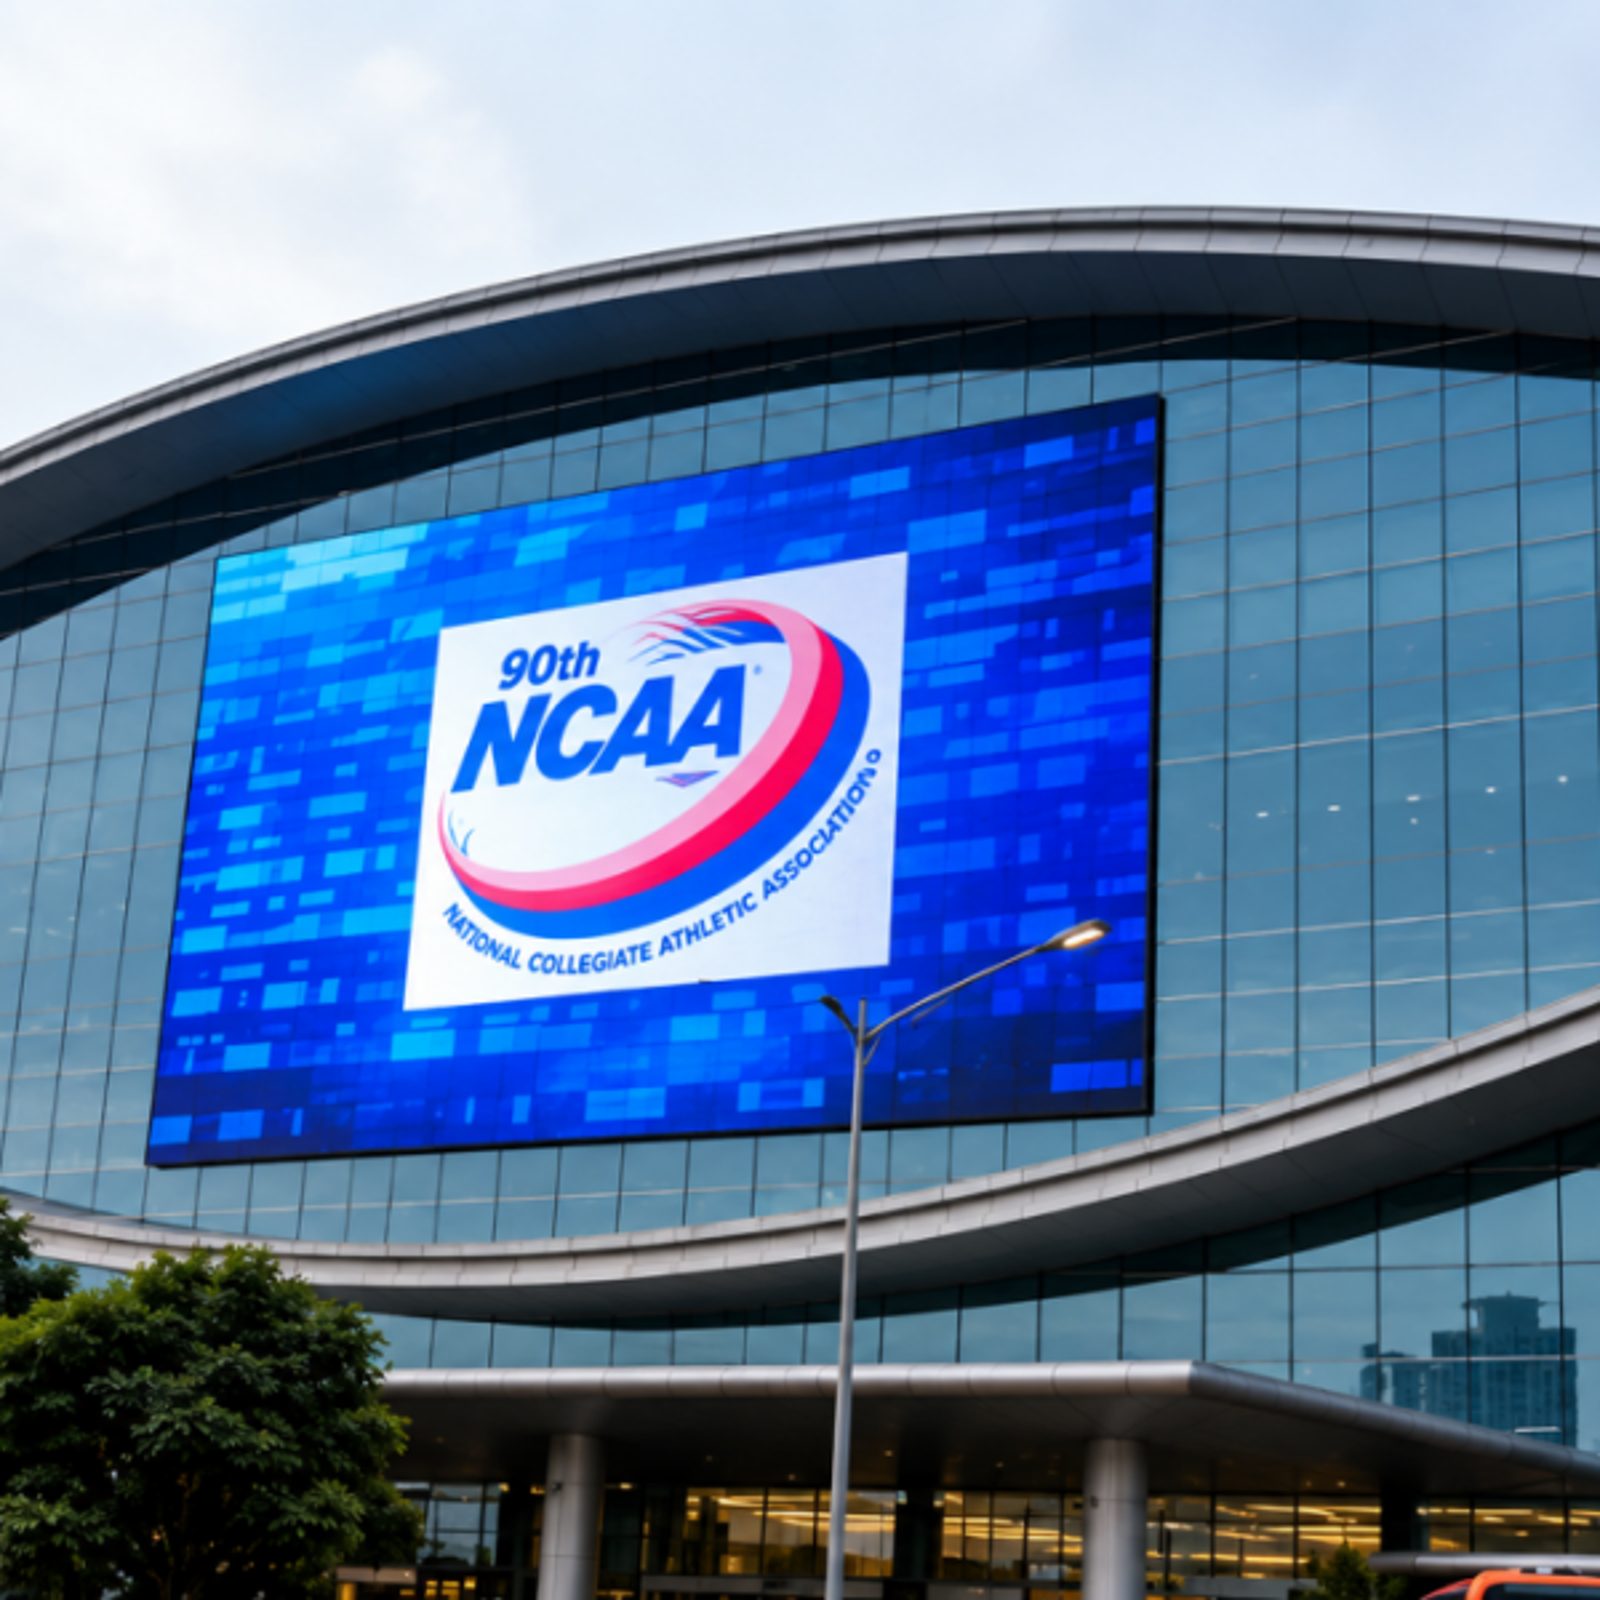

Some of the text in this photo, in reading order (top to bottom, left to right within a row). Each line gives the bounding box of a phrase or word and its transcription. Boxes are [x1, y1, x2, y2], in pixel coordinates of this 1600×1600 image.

[450, 664, 746, 793] NCAA
[499, 641, 600, 690] 90th
[443, 767, 877, 975] NATIONAL COLLEGIATE ATHLETIC ASSOCIATION
